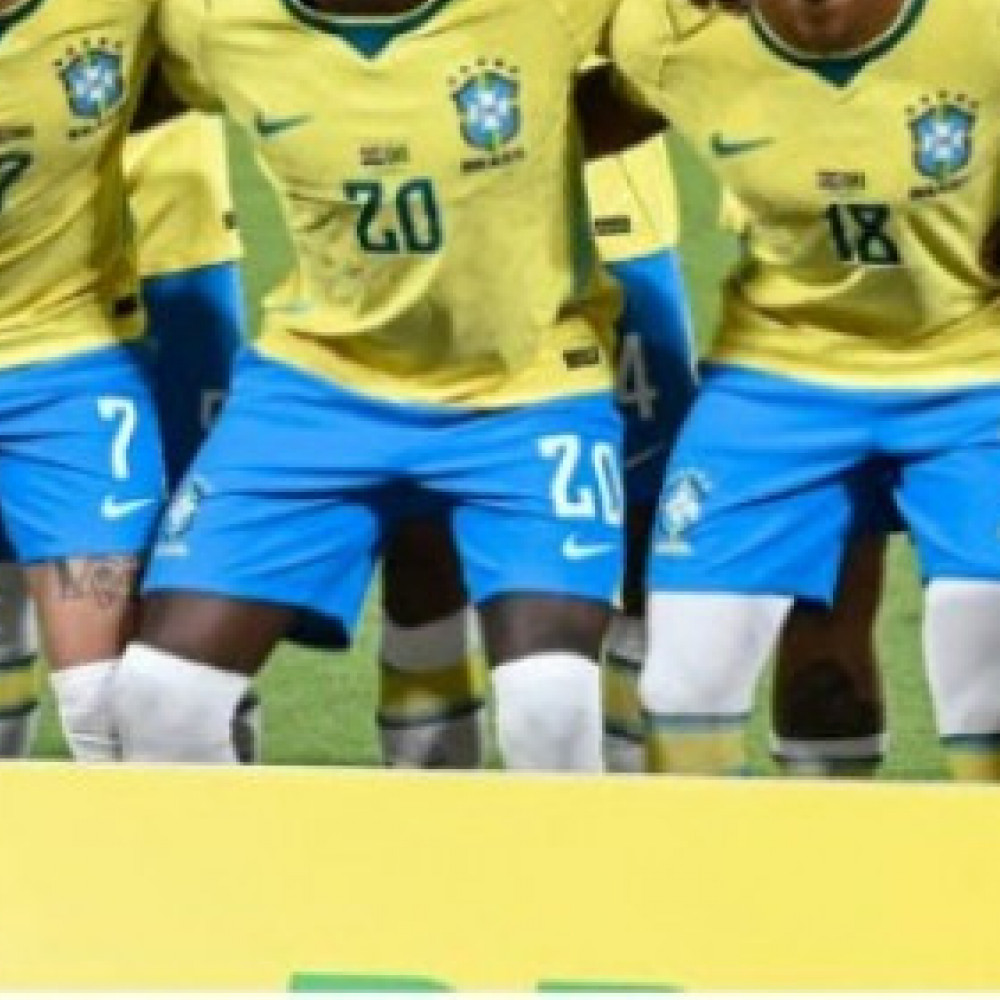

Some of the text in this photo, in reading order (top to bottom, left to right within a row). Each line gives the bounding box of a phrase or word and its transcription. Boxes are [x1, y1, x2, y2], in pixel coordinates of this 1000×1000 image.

[342, 178, 443, 255] 20
[826, 202, 902, 265] 18
[617, 331, 658, 420] 4
[96, 395, 138, 481] 7
[536, 432, 624, 526] 20
